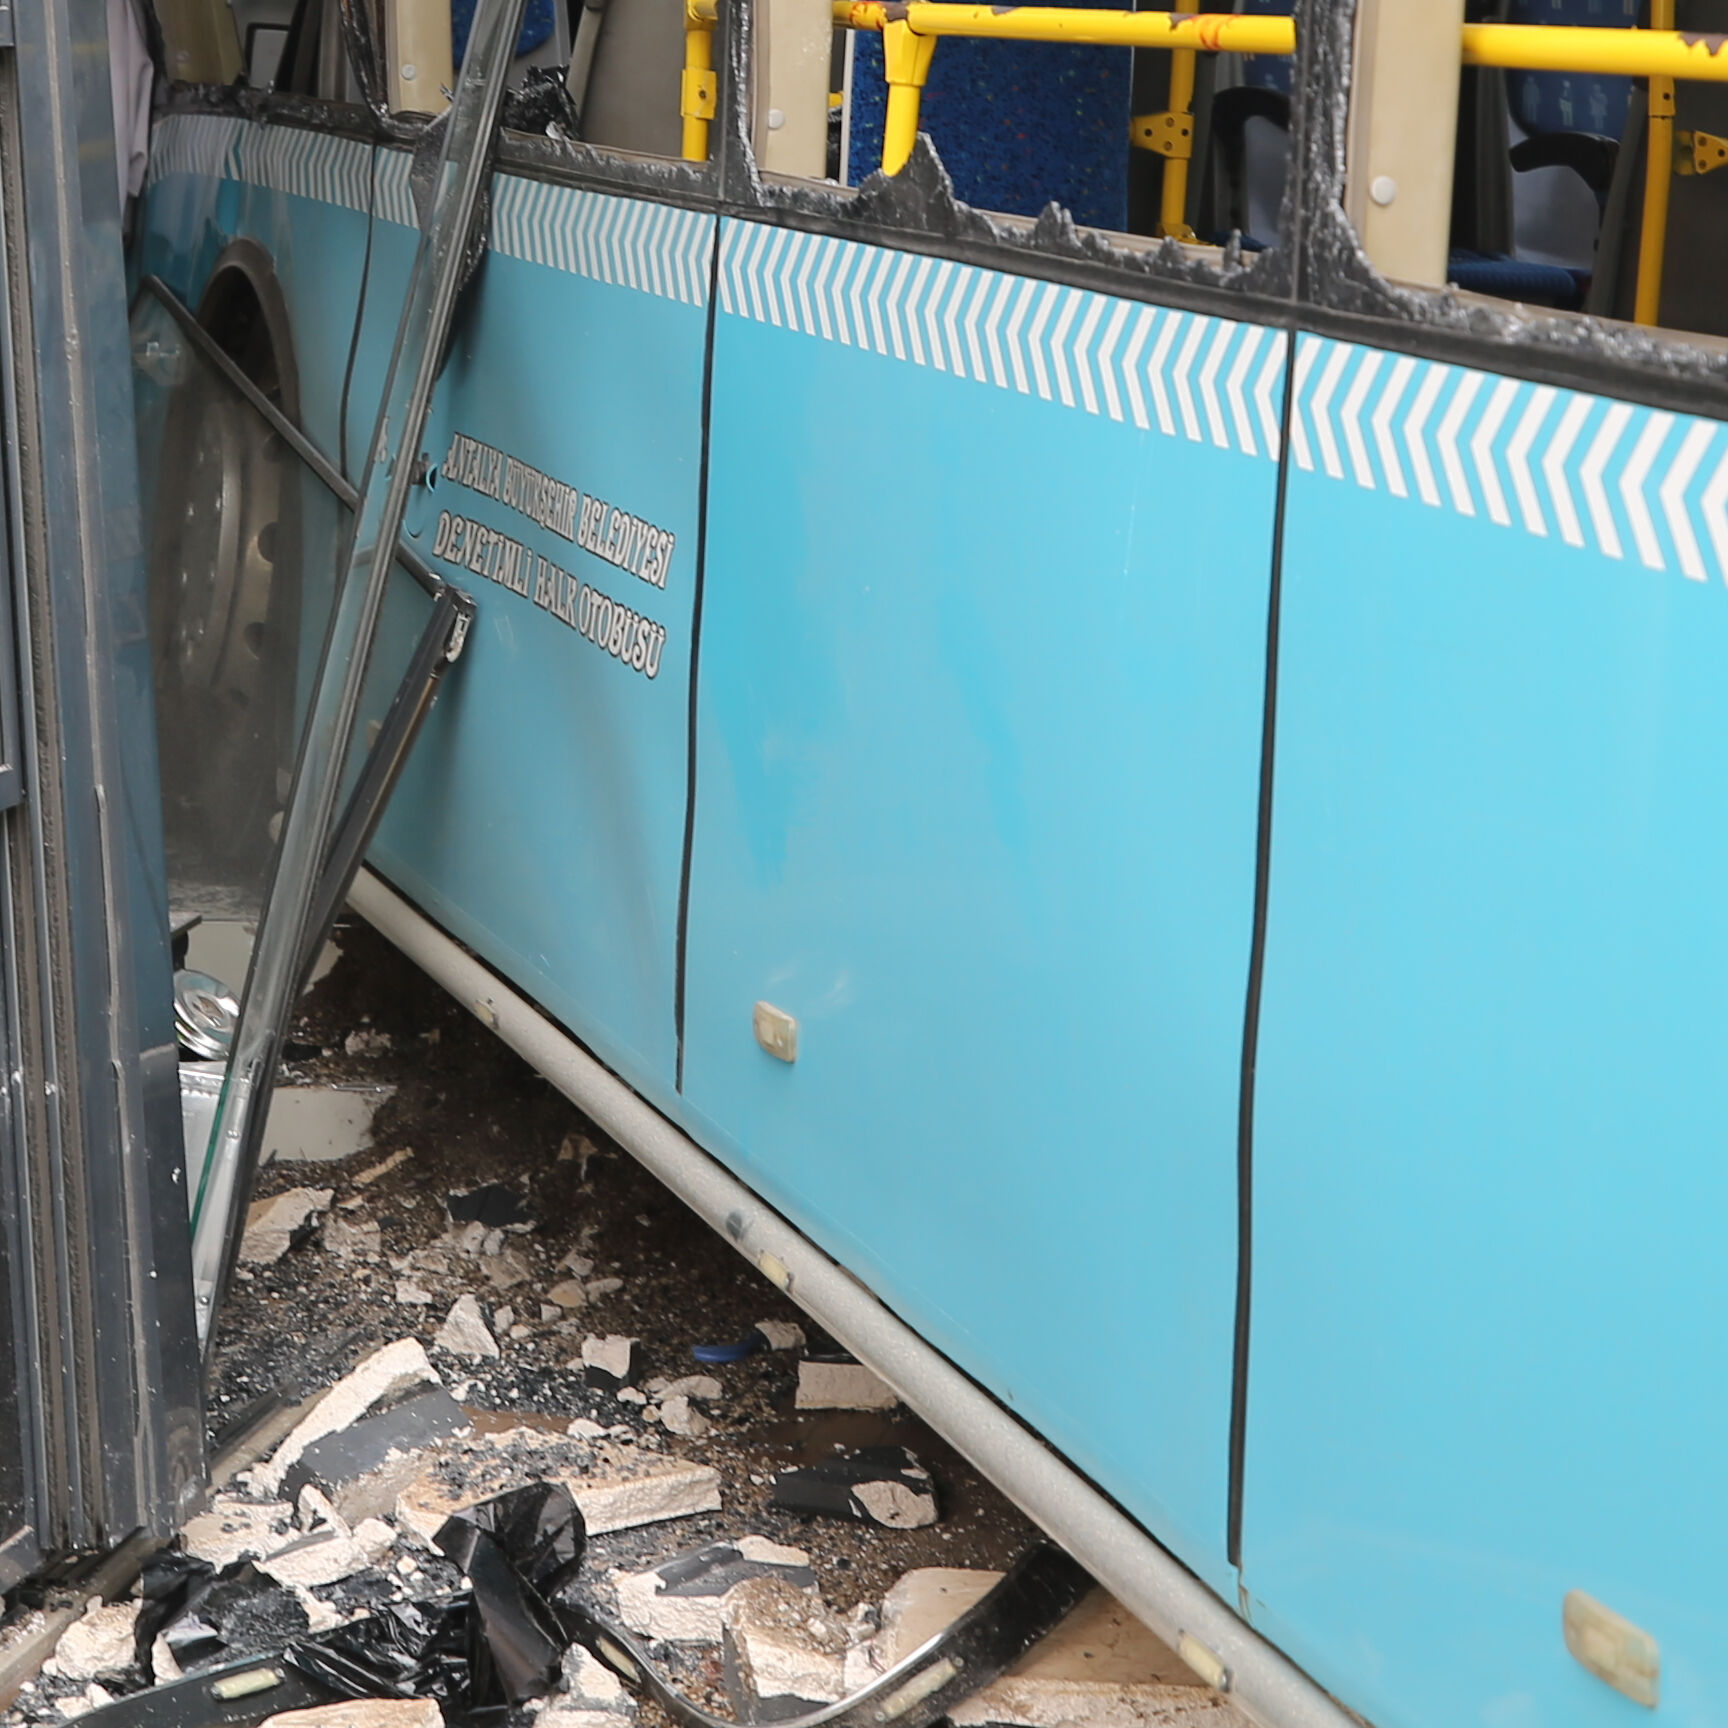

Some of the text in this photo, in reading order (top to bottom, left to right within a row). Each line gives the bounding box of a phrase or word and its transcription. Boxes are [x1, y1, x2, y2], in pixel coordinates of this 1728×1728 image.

[441, 432, 503, 502] ANTALYA
[577, 494, 675, 589] BELEDİYESİ
[432, 509, 666, 679] DENETİMLİ HALK OTOBÜSÜ
